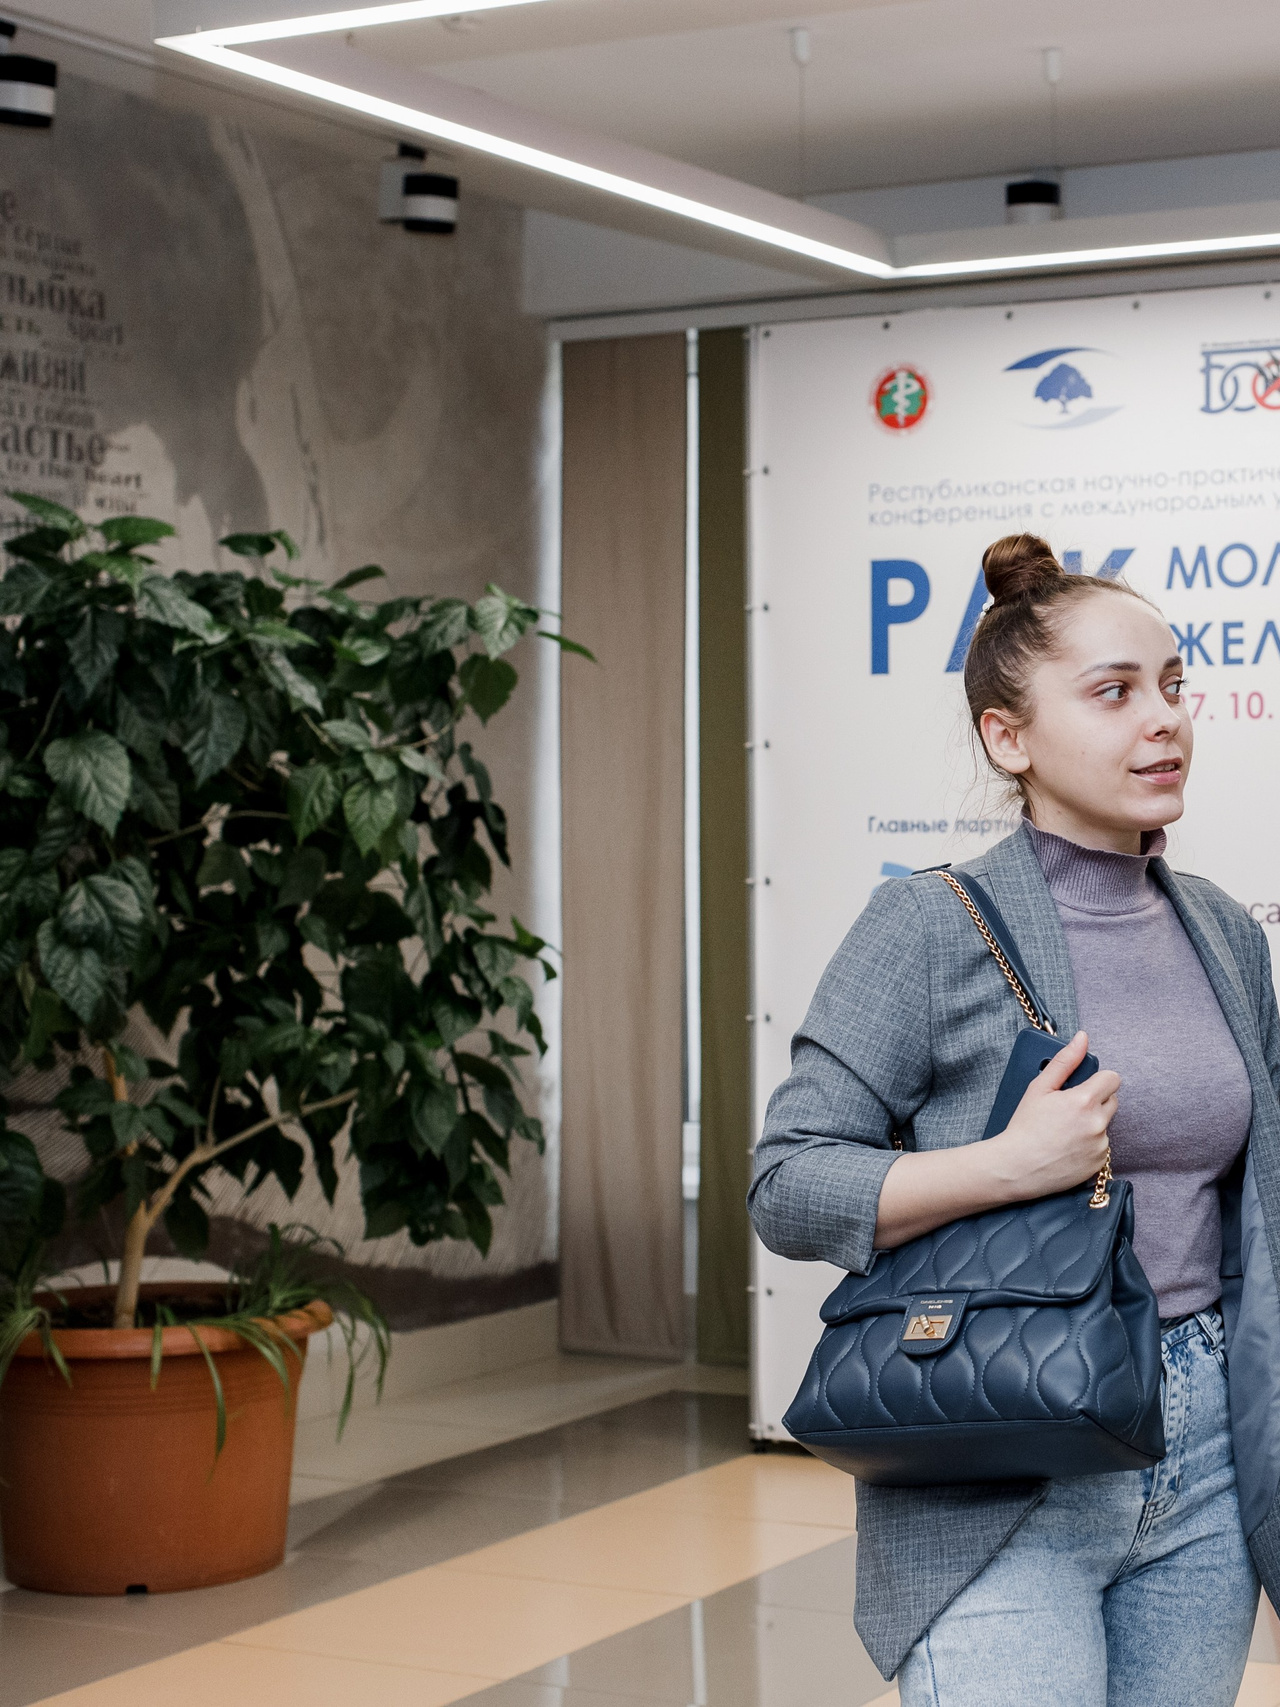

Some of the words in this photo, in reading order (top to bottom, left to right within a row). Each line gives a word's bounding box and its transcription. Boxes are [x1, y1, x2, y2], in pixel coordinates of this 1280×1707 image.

[868, 477, 1076, 505] Республиканская
[868, 502, 1033, 527] конференция
[1041, 501, 1055, 518] с
[1061, 493, 1266, 519] международным
[1181, 693, 1214, 720] 7.
[1231, 691, 1273, 720] 10.
[868, 815, 948, 834] Главные
[955, 817, 1020, 837] партн
